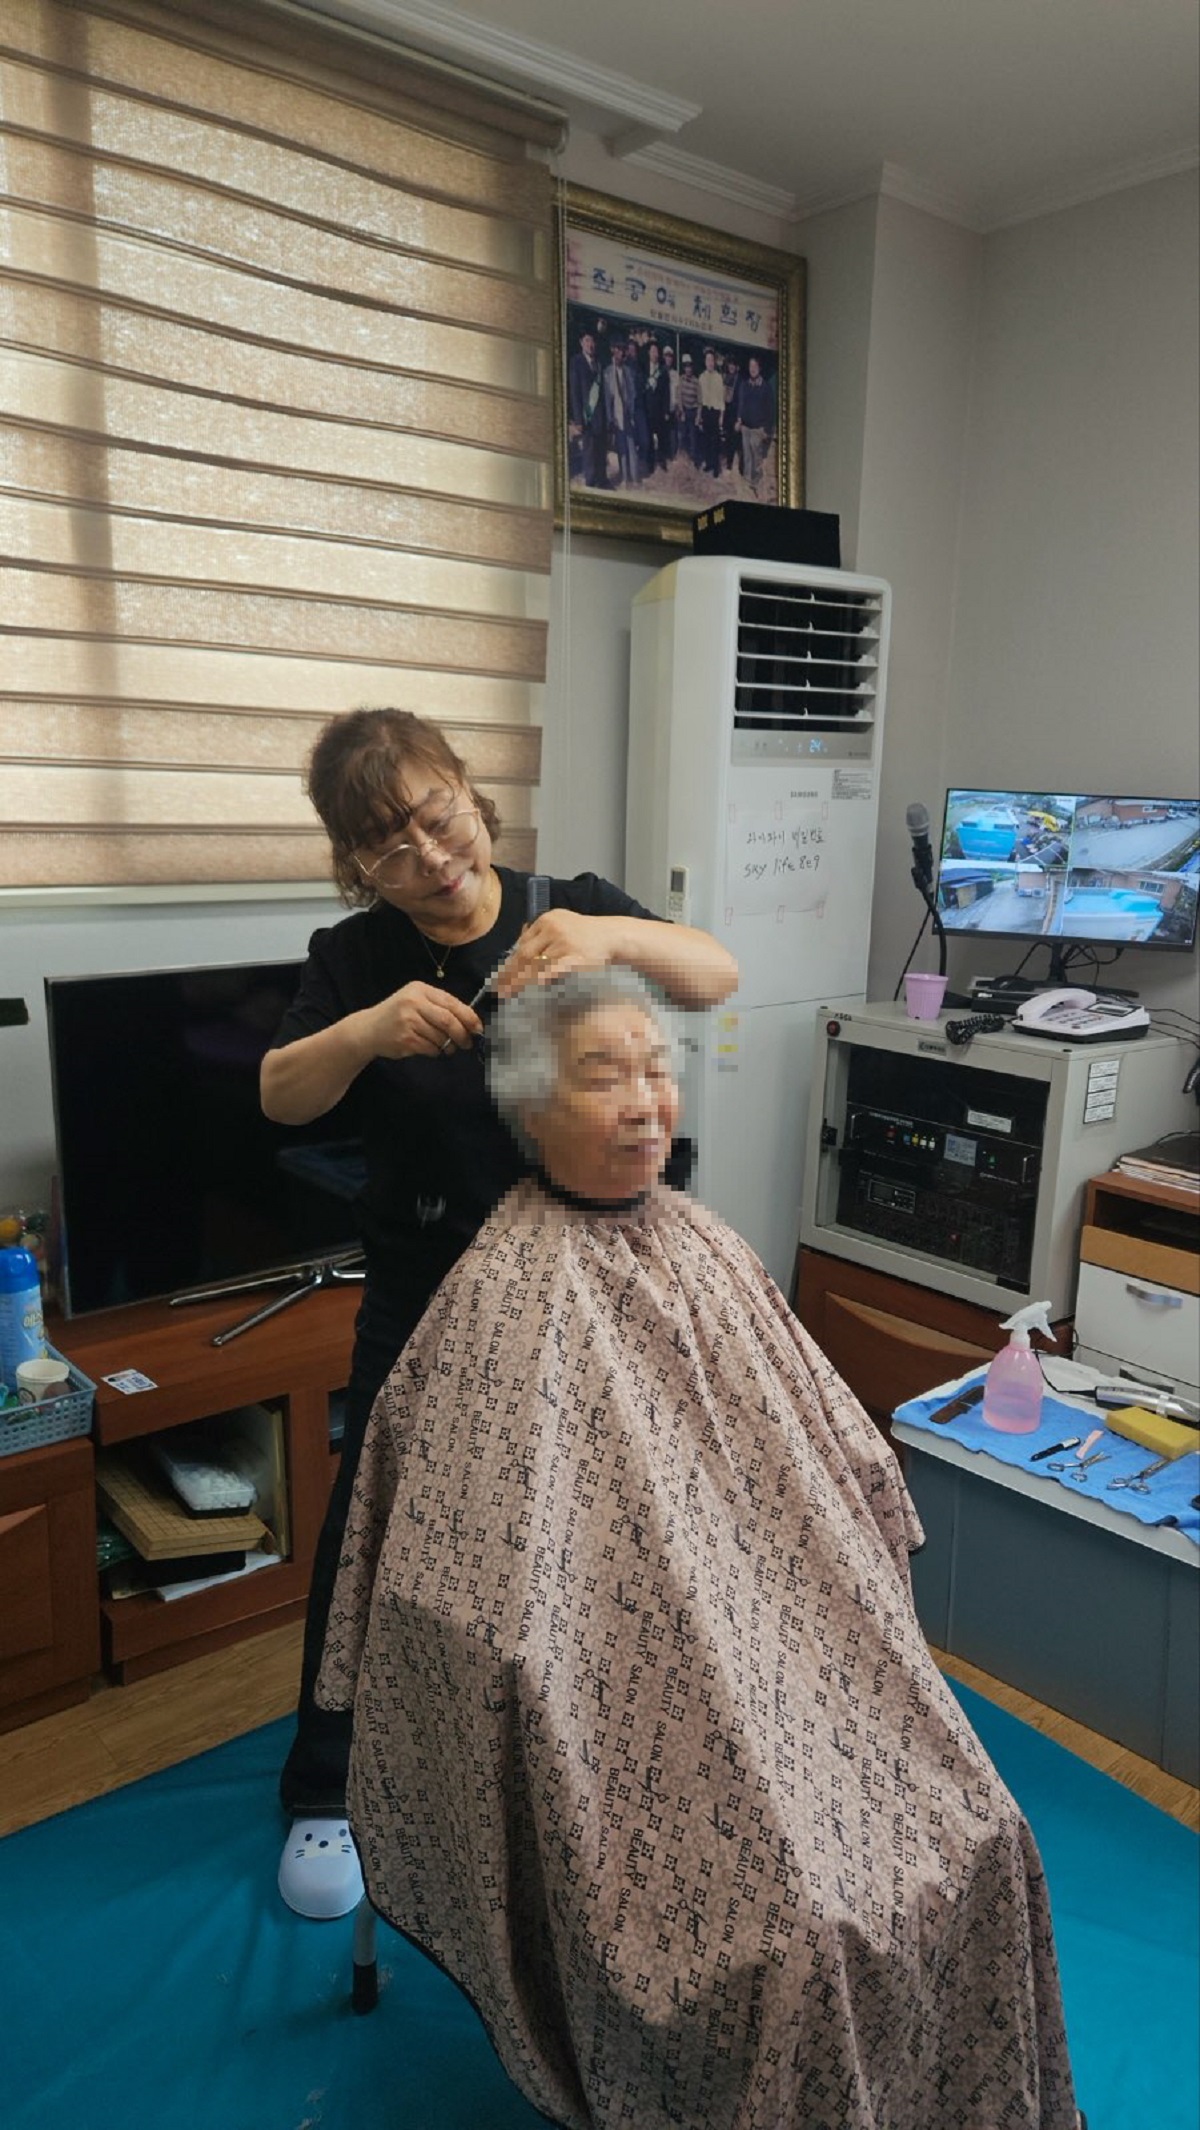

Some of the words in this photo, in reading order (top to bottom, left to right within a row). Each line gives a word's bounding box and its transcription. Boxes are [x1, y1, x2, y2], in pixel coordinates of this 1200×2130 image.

[470, 1279, 484, 1312] SALON
[498, 1279, 518, 1316] BEAUTY
[489, 1321, 505, 1355] SALON
[582, 1317, 598, 1350] SALON
[710, 1333, 724, 1366] SALON
[601, 1365, 618, 1401] SALON
[447, 1417, 459, 1453] SALON
[467, 1410, 482, 1454] BEAUTY
[672, 1399, 689, 1432] SALON
[392, 1422, 408, 1455] SALON
[460, 1462, 472, 1500] SALON
[548, 1454, 560, 1491] SALON
[572, 1459, 590, 1503] BEAUTY
[775, 1463, 791, 1499] SALON
[420, 1519, 437, 1565] BEAUTY
[564, 1507, 578, 1545] SALON
[798, 1514, 814, 1550] SALON
[410, 1571, 424, 1610] SALON
[433, 1566, 451, 1613] BEAUTY
[529, 1546, 546, 1594] BEAUTY
[518, 1599, 535, 1642] SALON
[548, 1604, 561, 1654] BEAUTY
[636, 1610, 654, 1659] BEAUTY
[751, 1598, 761, 1633] SALON
[778, 1604, 792, 1647] BEAUTY
[882, 1611, 895, 1655] BEAUTY
[434, 1619, 446, 1658] SALON
[538, 1659, 554, 1704] SALON
[626, 1663, 643, 1706] SALON
[660, 1666, 679, 1716] BEAUTY
[872, 1659, 888, 1697] SALON
[906, 1664, 921, 1709] BEAUTY
[650, 1720, 667, 1762] SALON
[899, 1714, 915, 1753] SALON
[371, 1739, 389, 1774] SALON
[602, 1767, 620, 1818] BEAUTY
[860, 1757, 872, 1804] BEAUTY
[368, 1836, 382, 1871] SALON
[596, 1825, 610, 1870] SALON
[624, 1827, 644, 1880] BEAUTY
[892, 1812, 904, 1861] BEAUTY
[396, 1828, 416, 1866] BEAUTY
[408, 1872, 425, 1905] SALON
[732, 1837, 752, 1890] BEAUTY
[892, 1865, 904, 1909] SALON
[613, 1887, 631, 1933] SALON
[722, 1897, 740, 1945] SALON
[758, 1901, 780, 1958] BEAUTY
